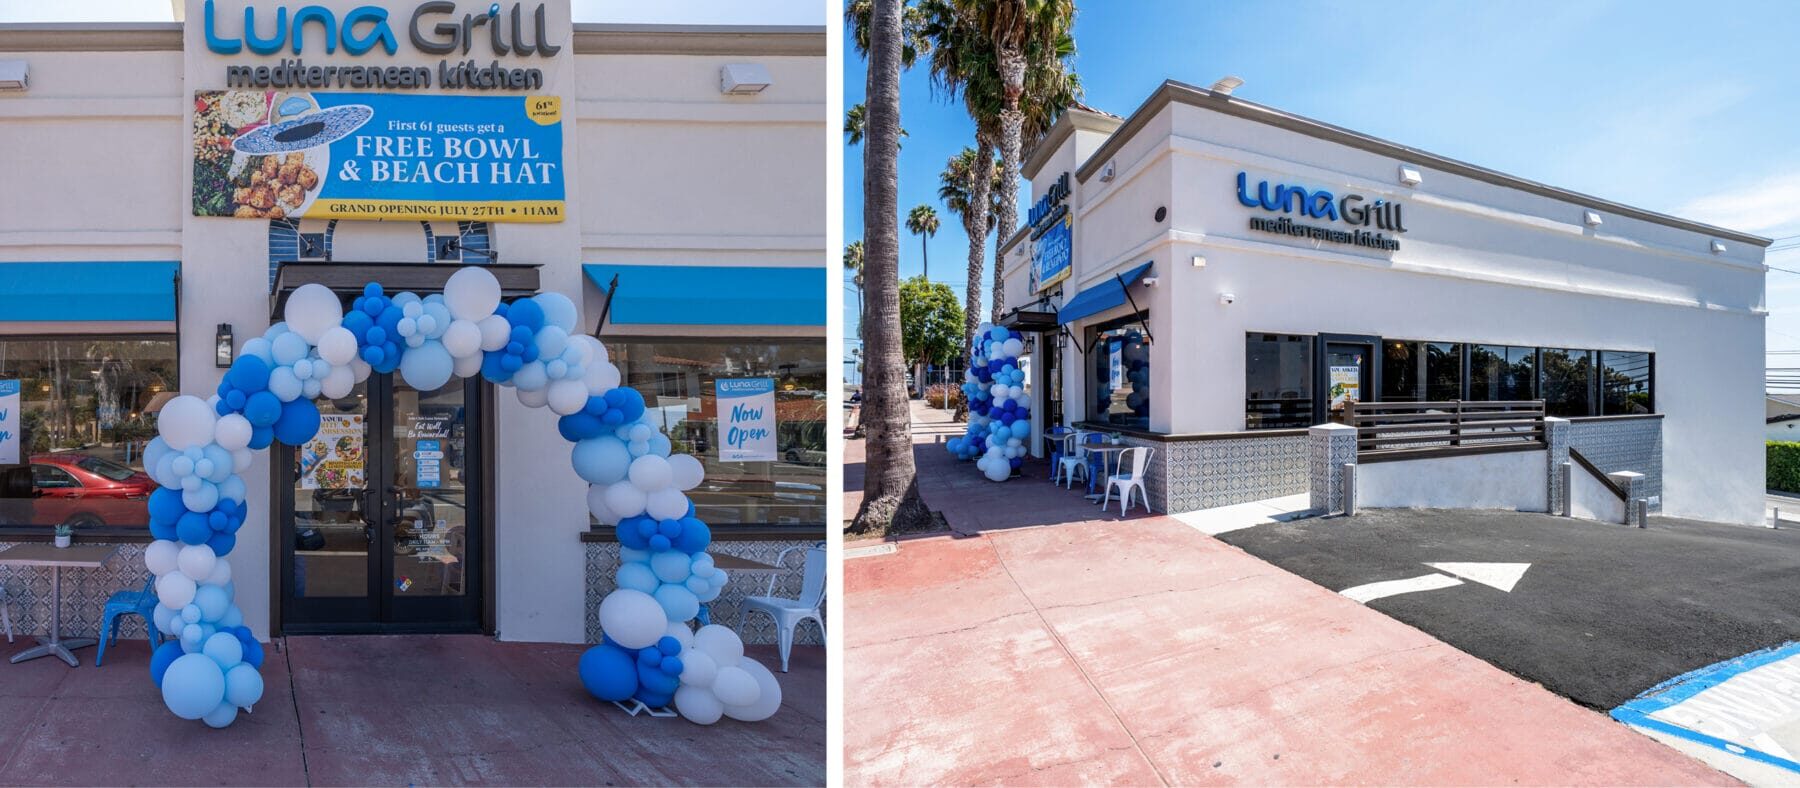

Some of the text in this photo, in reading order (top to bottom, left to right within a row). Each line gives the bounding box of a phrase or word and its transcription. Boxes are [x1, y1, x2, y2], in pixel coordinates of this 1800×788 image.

[204, 0, 561, 57] Luna Grill
[227, 59, 543, 90] mediterranean kitchen
[388, 120, 505, 133] First 61 guests get a
[356, 136, 540, 160] FREE BOWL
[339, 159, 556, 184] & BEACH HAT
[330, 204, 559, 216] GRAND OPENING JULY 27TH 11AM
[1237, 171, 1408, 233] Luna Grill
[1249, 217, 1400, 251] mediterranean kitchen
[730, 403, 763, 423] Now
[727, 426, 770, 449] Open
